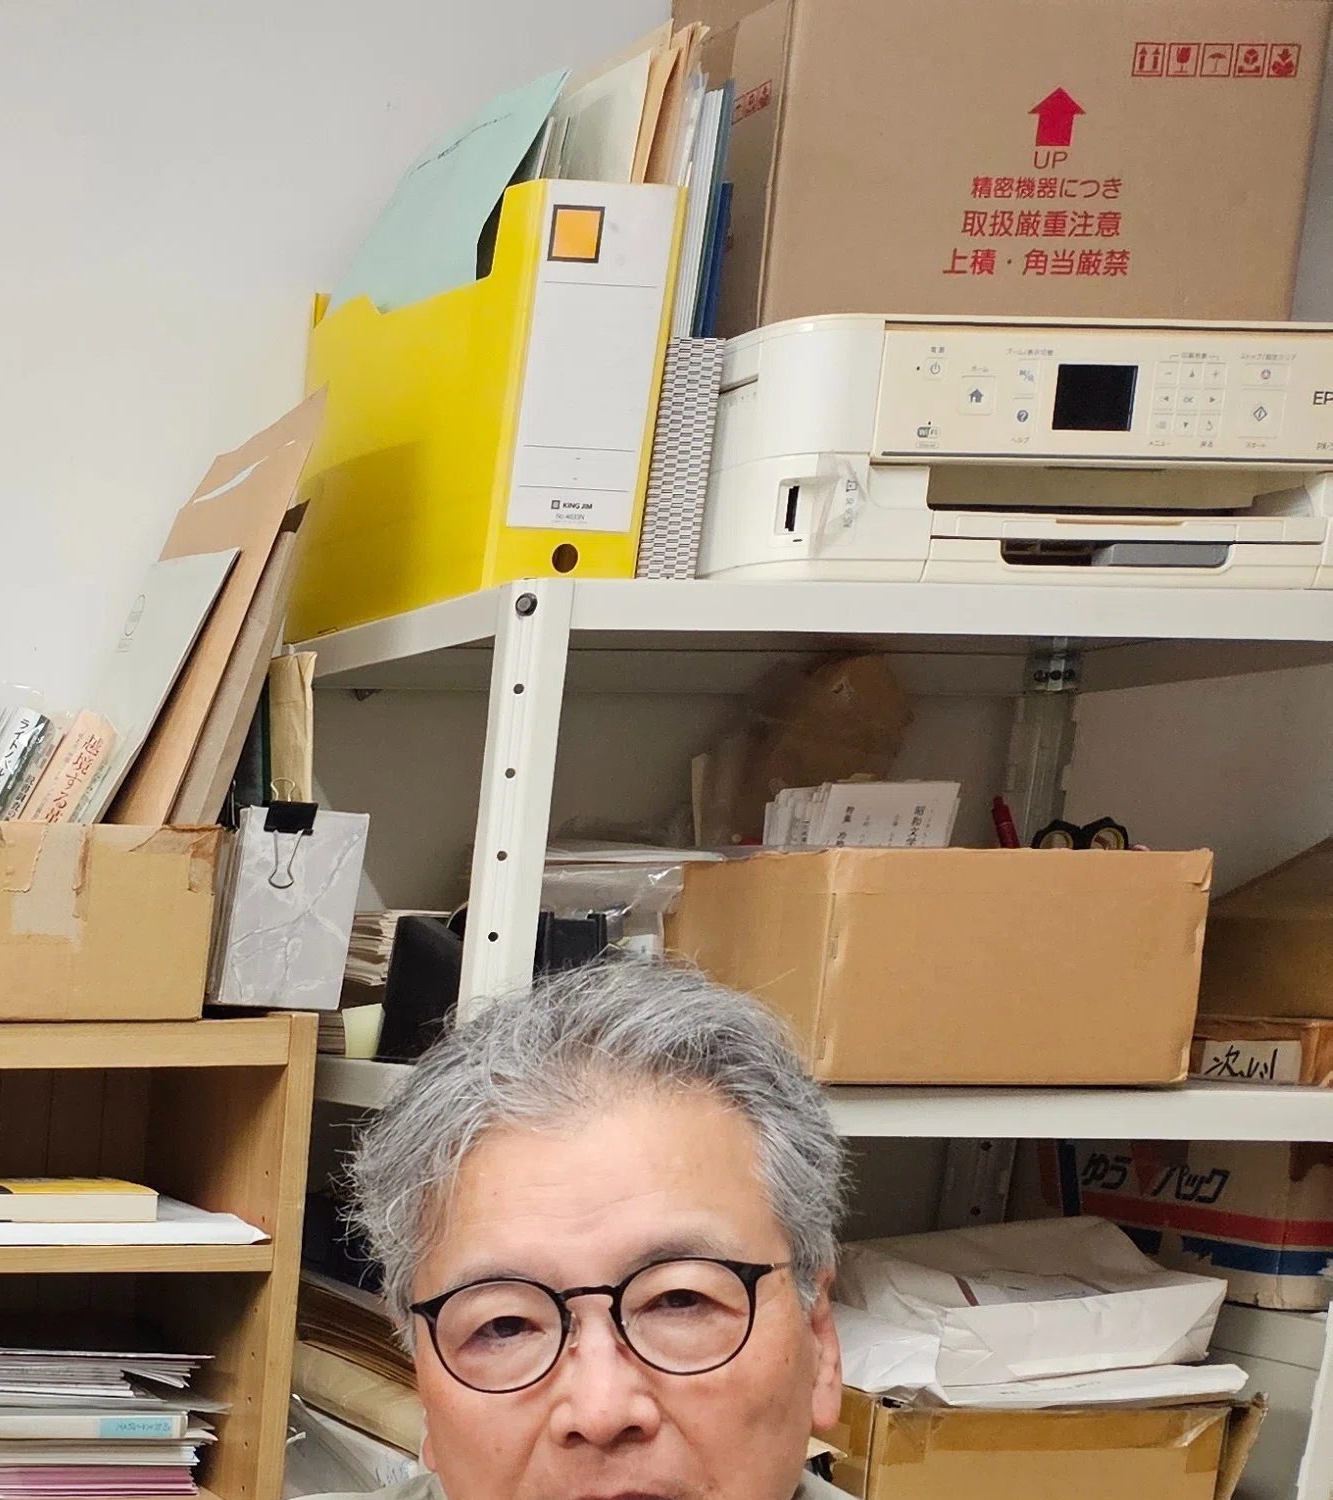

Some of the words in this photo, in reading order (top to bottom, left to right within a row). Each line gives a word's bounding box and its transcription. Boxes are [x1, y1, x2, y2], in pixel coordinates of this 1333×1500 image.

[1032, 150, 1070, 170] UP
[970, 175, 1123, 200] 精密機器につき
[961, 210, 1123, 239] 取扱厳重注意
[943, 247, 1132, 277] 上積・角当厳禁
[970, 364, 989, 374] ホーム
[1010, 436, 1030, 445] ヘルプ
[1148, 440, 1172, 448] メニュー
[1244, 441, 1268, 450] スタート
[562, 500, 580, 510] KING
[581, 502, 594, 511] JIM
